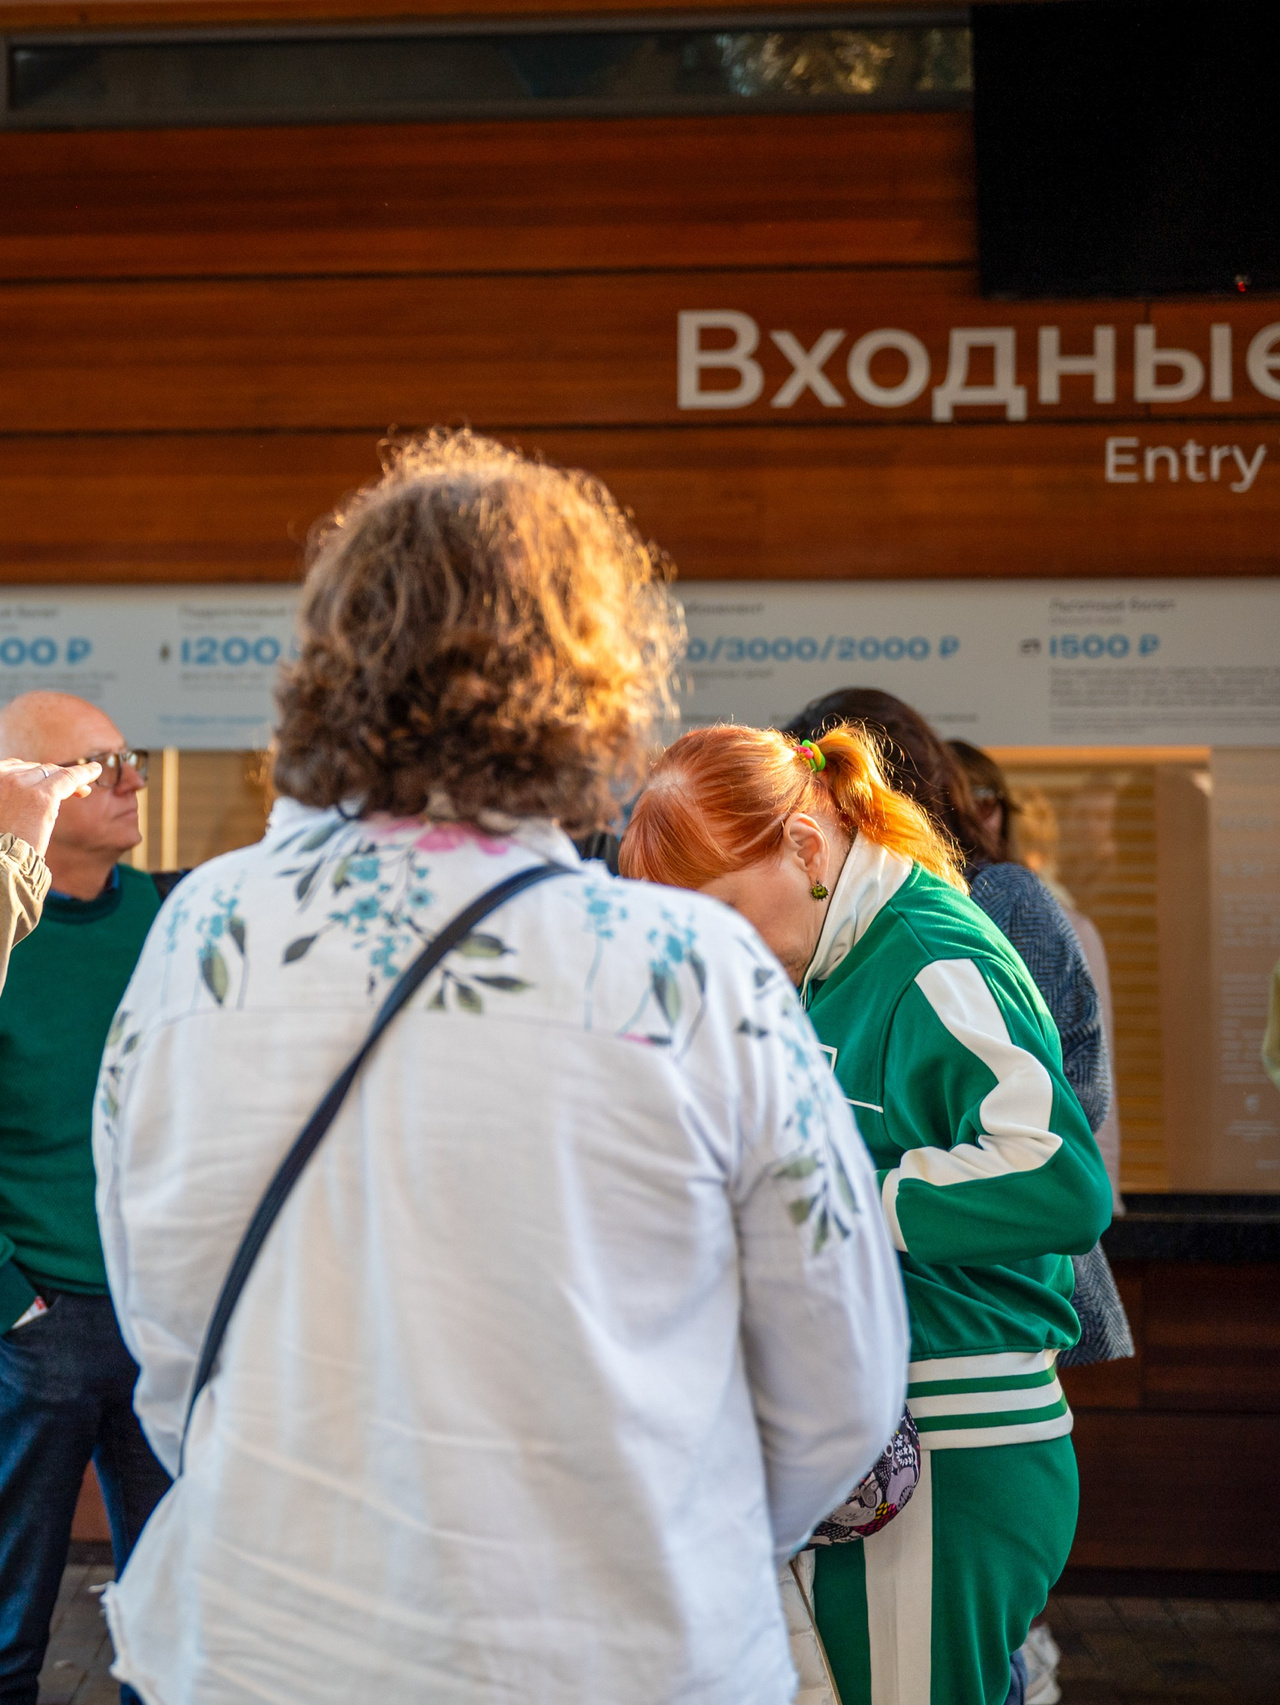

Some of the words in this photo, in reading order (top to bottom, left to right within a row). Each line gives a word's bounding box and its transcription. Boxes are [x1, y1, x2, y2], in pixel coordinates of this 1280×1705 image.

[1105, 437, 1267, 493] Entry
[683, 603, 763, 615] бонемент
[180, 636, 280, 666] 1200
[678, 634, 930, 663] 0/3000/2000
[1049, 634, 1130, 659] 1500
